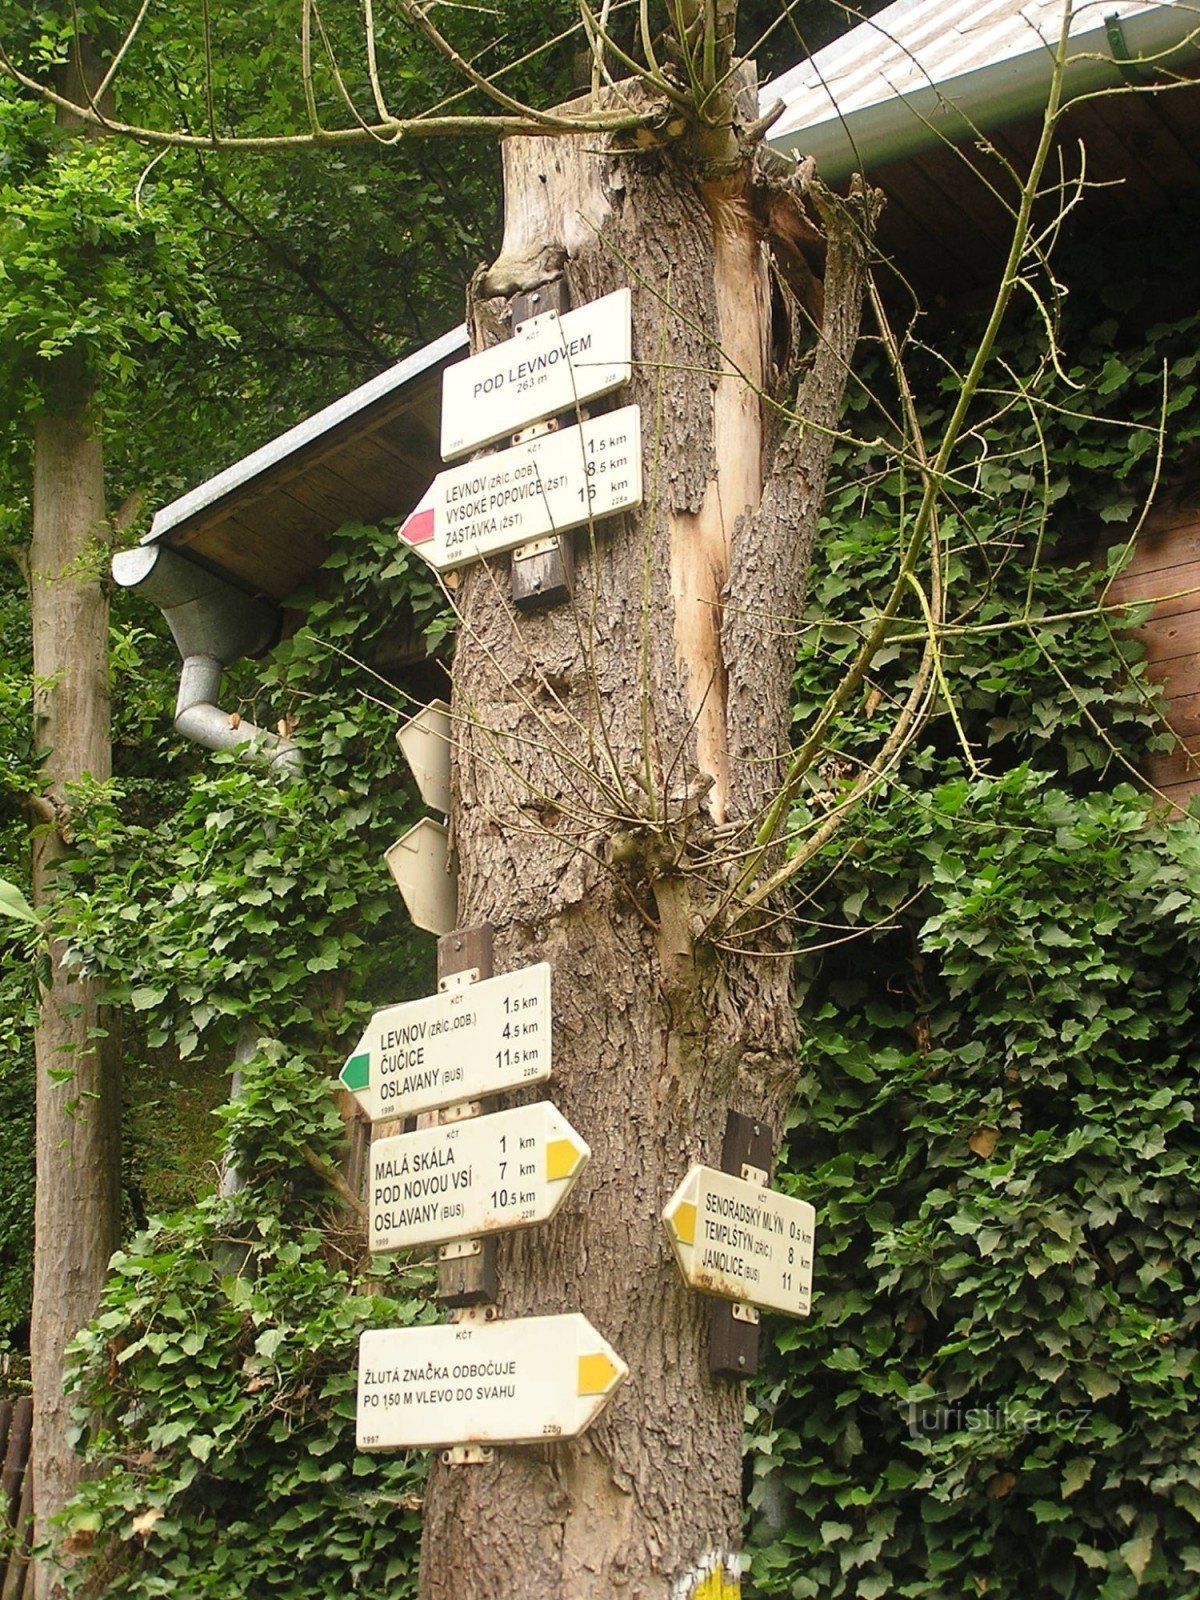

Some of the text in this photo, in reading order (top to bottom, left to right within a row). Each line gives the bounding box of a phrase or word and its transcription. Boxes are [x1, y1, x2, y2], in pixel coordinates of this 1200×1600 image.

[473, 334, 592, 398] POD LEVNOVEM
[516, 374, 547, 393] 263 m
[446, 476, 487, 503] LEVNOV
[588, 439, 606, 453] 1.5
[609, 435, 627, 447] km
[446, 457, 628, 524] VYSOKÉ POPOVICE (ŽST) 8.5 km
[445, 479, 628, 547] ZASTÁVKA (ŽST) 16 km
[381, 1022, 427, 1051] LEVNOV
[503, 997, 520, 1014] 1.5
[522, 996, 538, 1009] km
[450, 995, 464, 1005] KČT
[380, 1022, 538, 1075] ČUČICE 4.5 km
[380, 1048, 538, 1100] OSLAVANY (BUS) 11.5 km
[375, 1135, 535, 1181] MALÁ SKÁLA 1 km
[446, 1130, 460, 1140] KČT
[375, 1162, 536, 1206] POD NOVOU VSÍ 7 km
[374, 1189, 536, 1231] OSLAVANY (BUS) 10.5 km
[705, 1192, 812, 1245] SENOŘADSKÝ MLÝN 0.5 km
[704, 1220, 753, 1252] TEMPLŠTÝN
[788, 1247, 794, 1265] 8
[800, 1256, 810, 1269] km
[702, 1248, 809, 1296] JAMOLICE (BUS) 11 km
[455, 1331, 473, 1340] KČT
[364, 1360, 516, 1385] ŽLUTÁ ZNAČKA ODBOČUJE
[363, 1385, 516, 1408] PO 150 M VLEVO DO SVAHU
[363, 1436, 379, 1444] 1997
